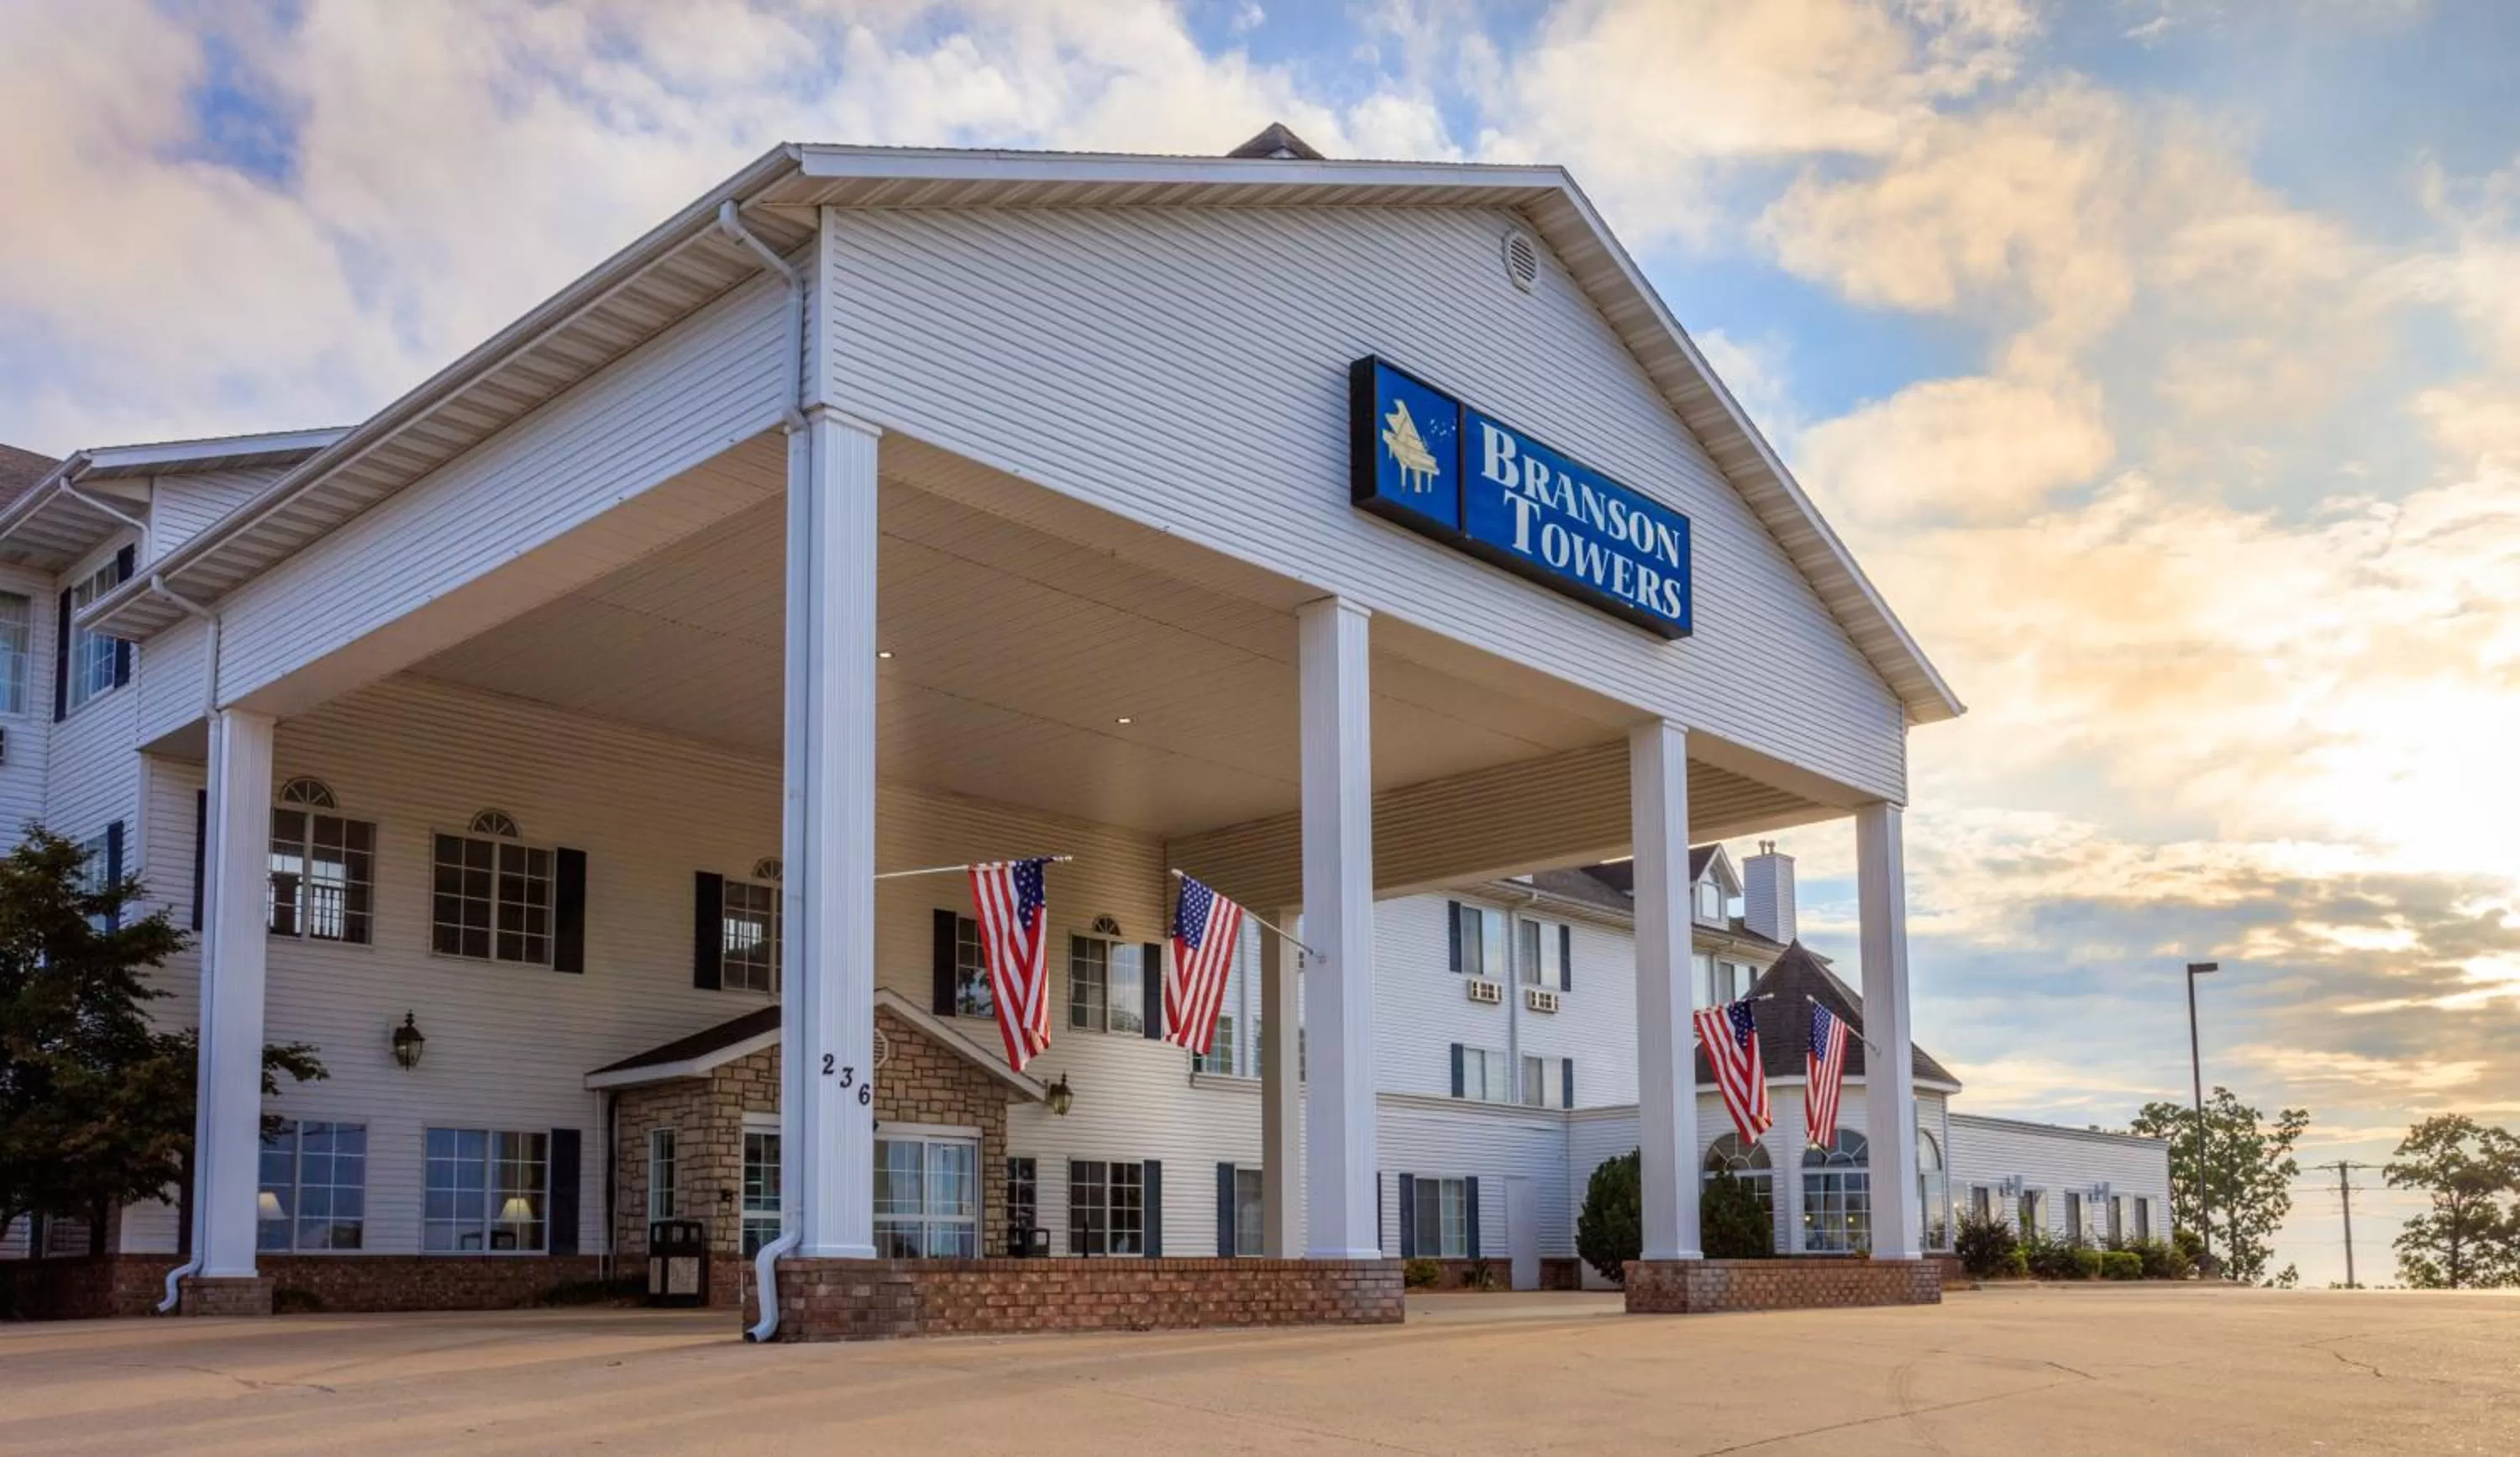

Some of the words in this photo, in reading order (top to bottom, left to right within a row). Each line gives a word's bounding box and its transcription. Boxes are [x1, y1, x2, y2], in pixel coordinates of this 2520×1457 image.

[1480, 421, 1680, 569] BRANSON
[1504, 489, 1681, 619] TOWERS
[822, 1053, 871, 1106] 236
